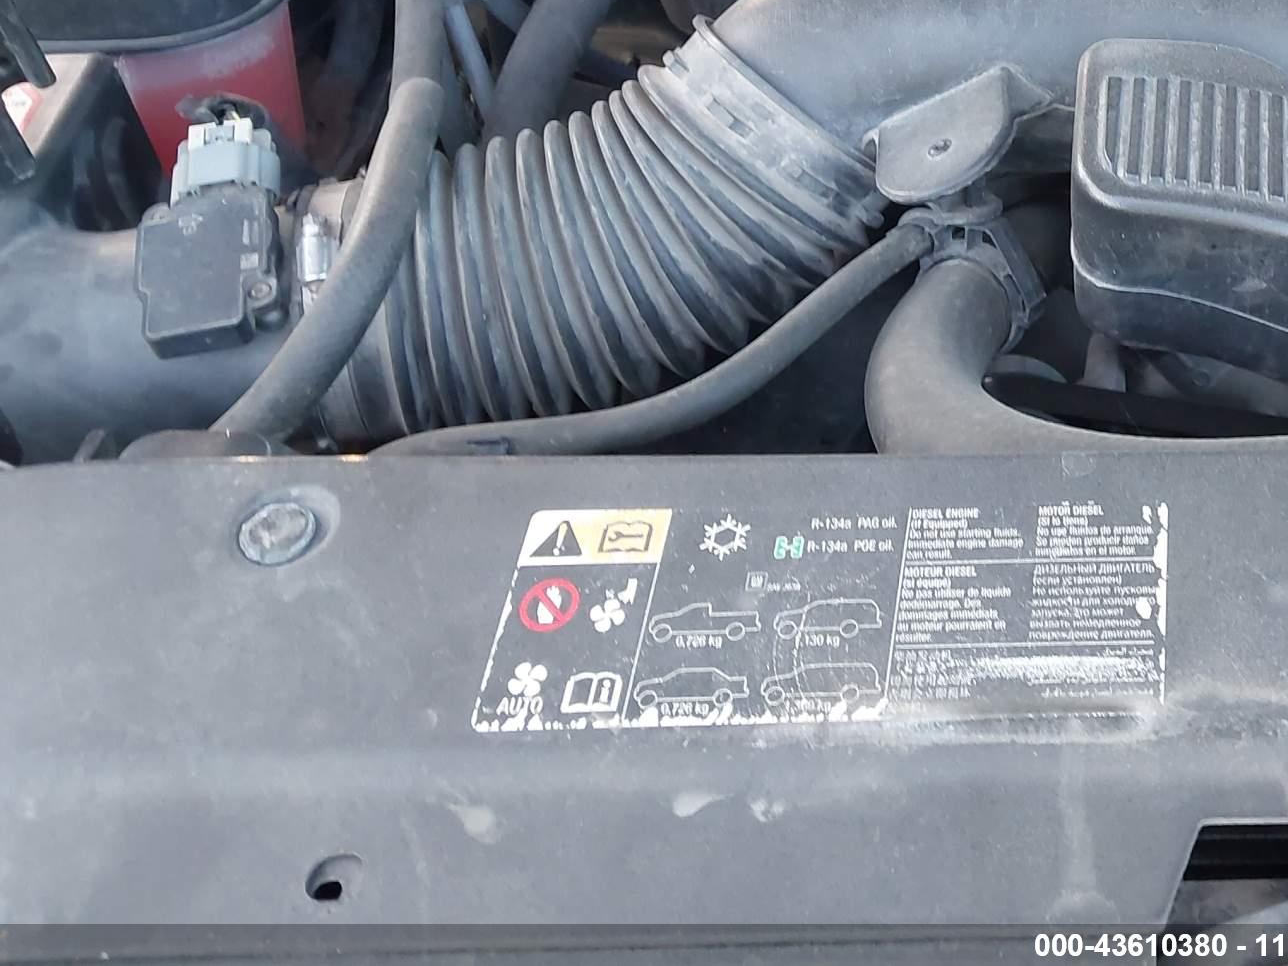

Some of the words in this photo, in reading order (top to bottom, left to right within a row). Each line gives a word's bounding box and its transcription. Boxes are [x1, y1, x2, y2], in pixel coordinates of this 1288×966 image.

[912, 507, 943, 519] DIESEL
[945, 507, 979, 519] ENGINE
[1038, 505, 1071, 516] MOTOR
[1072, 505, 1104, 516] DIESEL
[904, 566, 943, 578] MOTEUR
[944, 565, 977, 578] DIESEL
[708, 635, 723, 649] kg
[826, 634, 840, 649] kg
[496, 696, 543, 716] AUTO
[693, 702, 710, 717] kg
